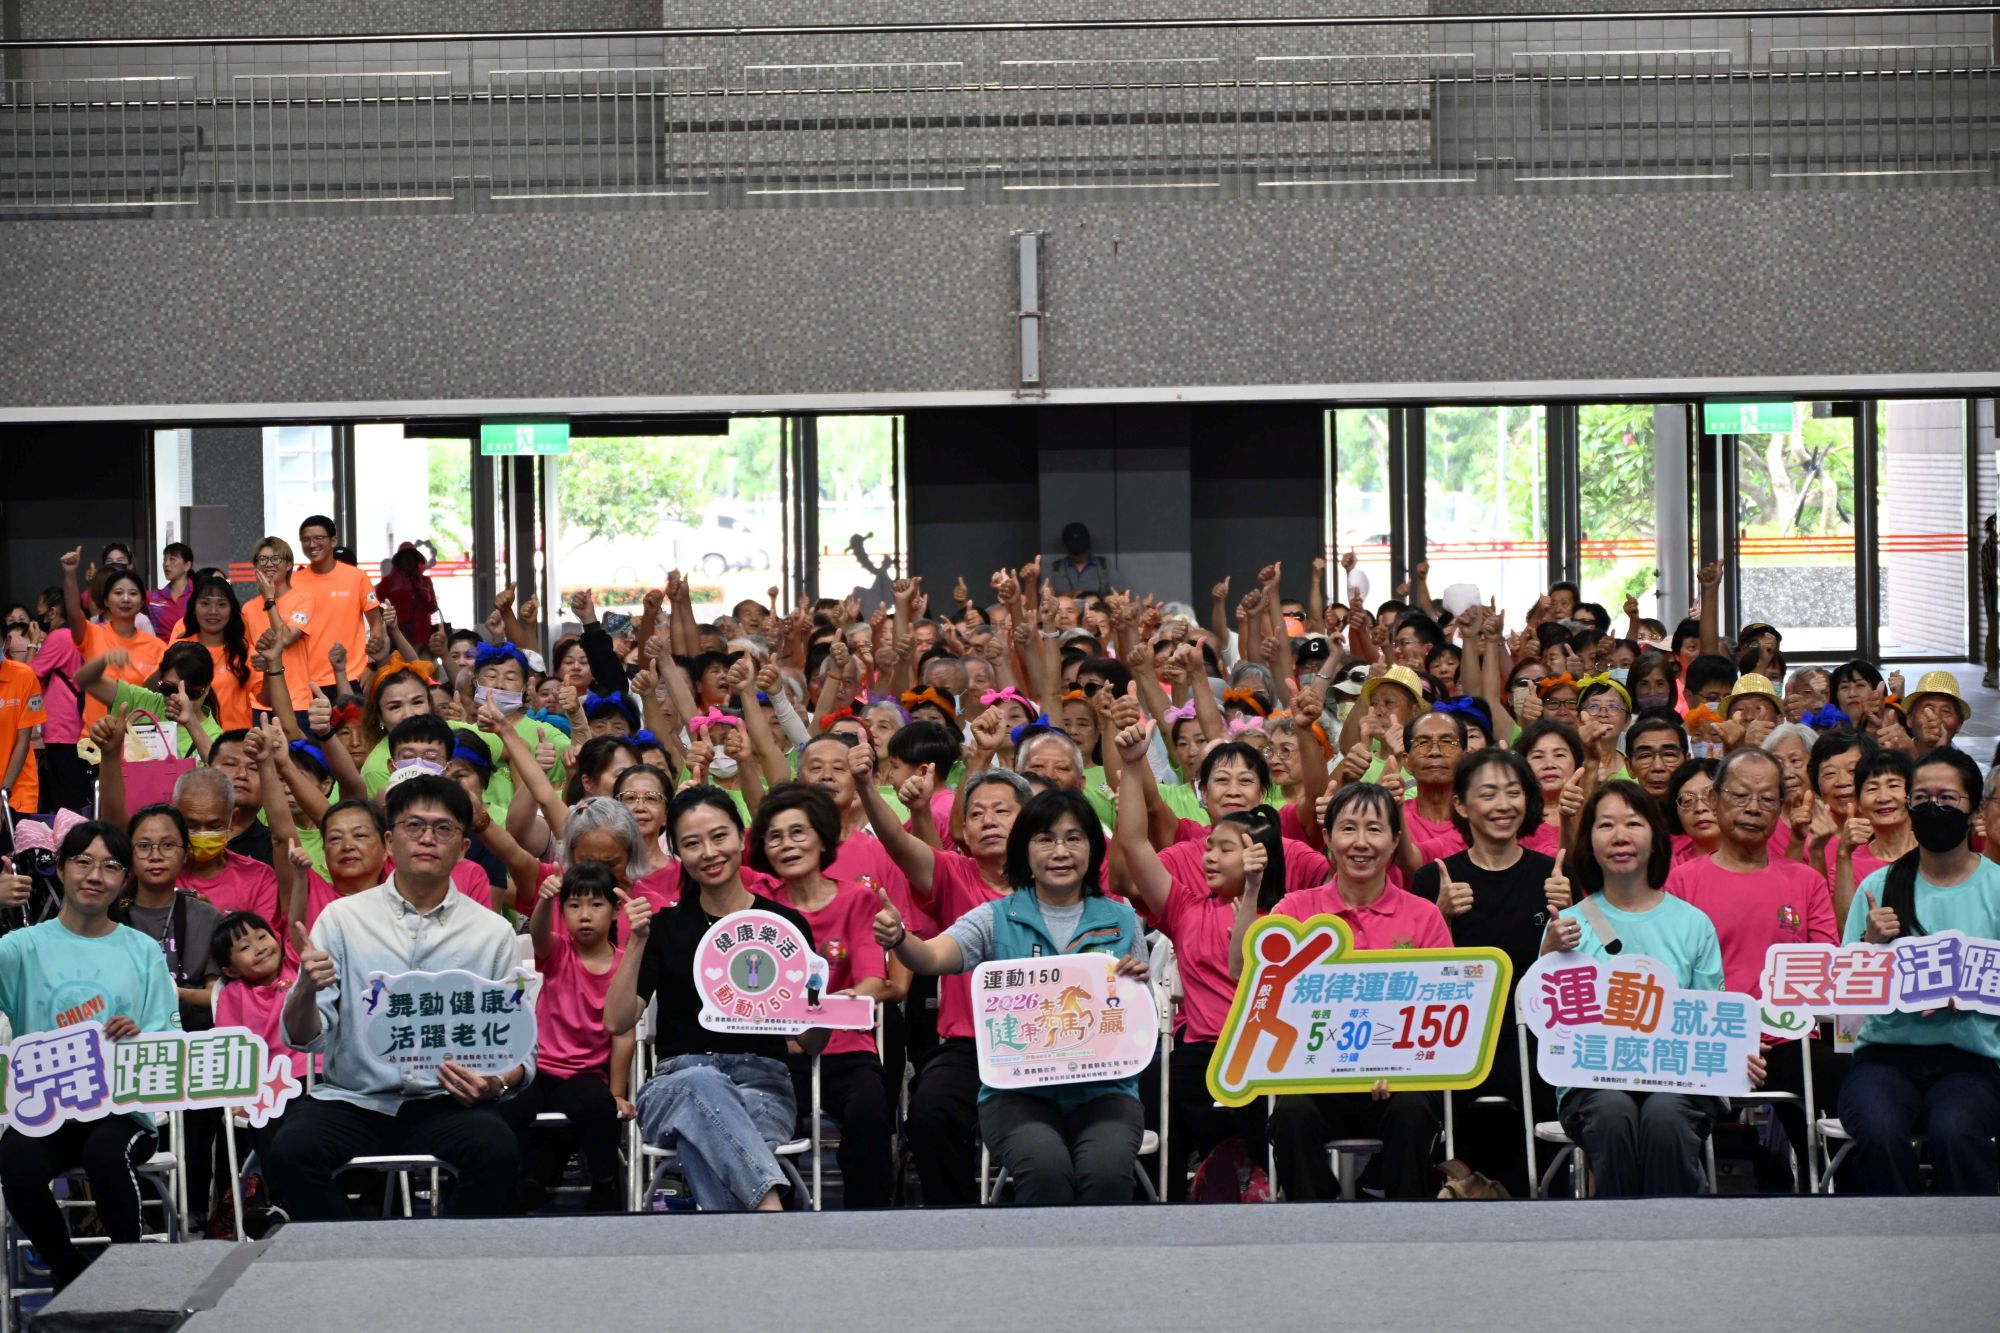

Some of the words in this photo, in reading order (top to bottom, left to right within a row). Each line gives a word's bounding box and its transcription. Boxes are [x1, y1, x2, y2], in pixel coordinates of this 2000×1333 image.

[1310, 641, 1319, 651] C
[714, 924, 798, 958] 健康樂活
[983, 968, 1060, 990] 運動150
[1770, 937, 2000, 1003] 長者活躍
[386, 990, 514, 1018] 舞動健康
[984, 994, 1039, 1012] 2026
[1248, 974, 1277, 1024] 一般成人
[1311, 1009, 1332, 1020] 每週
[1349, 1009, 1369, 1019] 每天
[376, 1022, 511, 1056] 活躍老化
[1305, 1055, 1316, 1064] 天
[1338, 1053, 1359, 1063] 分鐘
[1414, 1051, 1435, 1061] 分鐘
[1571, 1034, 1728, 1077] 這麼簡單
